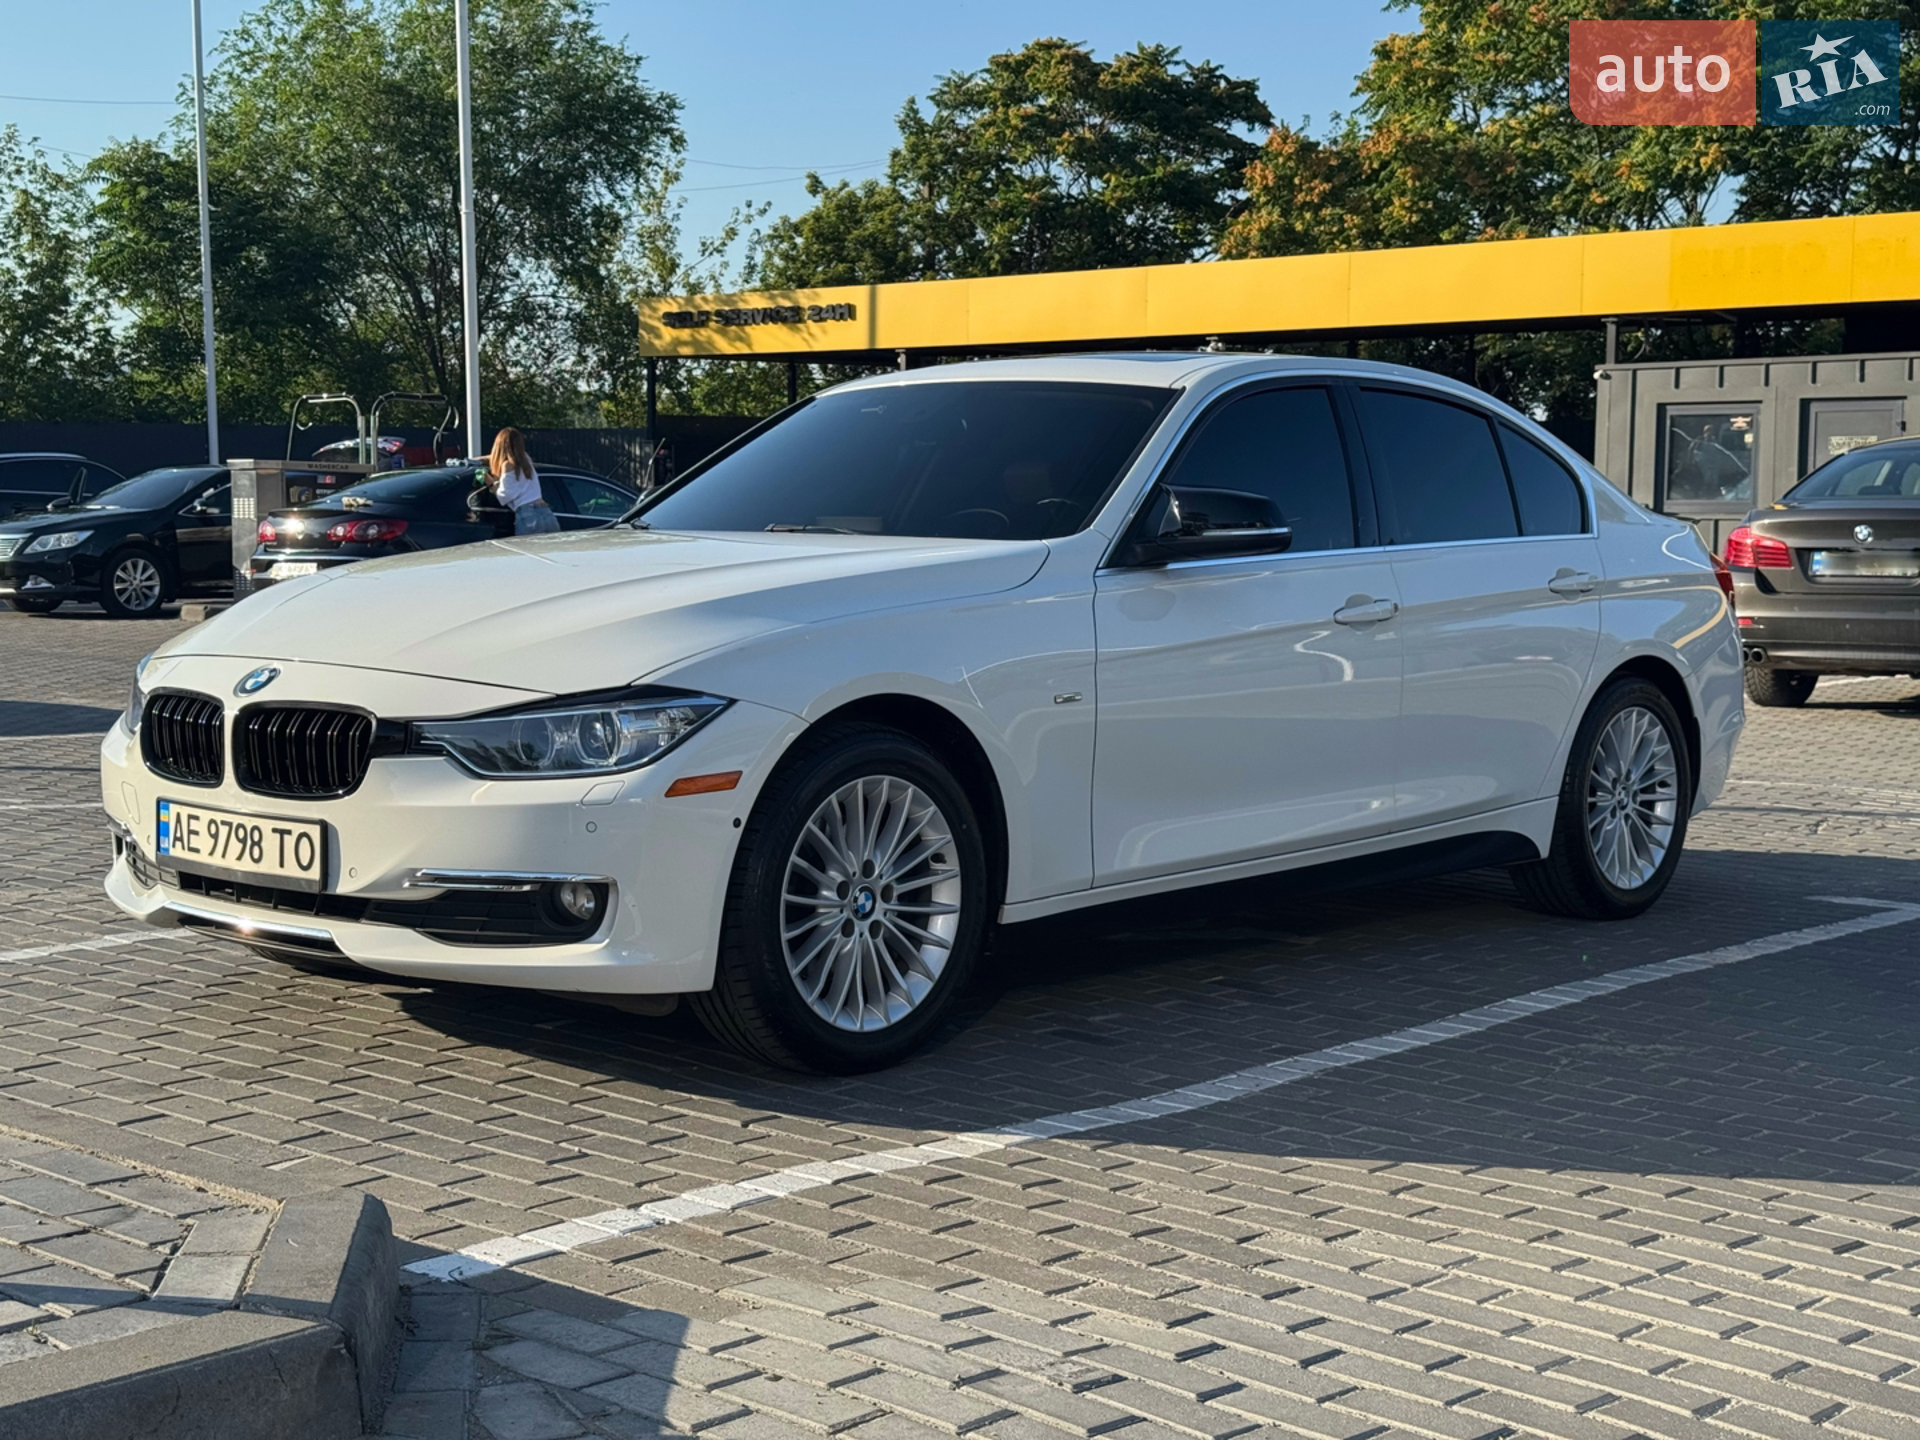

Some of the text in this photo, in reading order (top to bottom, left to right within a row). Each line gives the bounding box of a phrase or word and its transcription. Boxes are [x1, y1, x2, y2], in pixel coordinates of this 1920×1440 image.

[662, 303, 853, 328] SELF SERVICE 24H
[172, 811, 315, 872] AE 9798 TO
